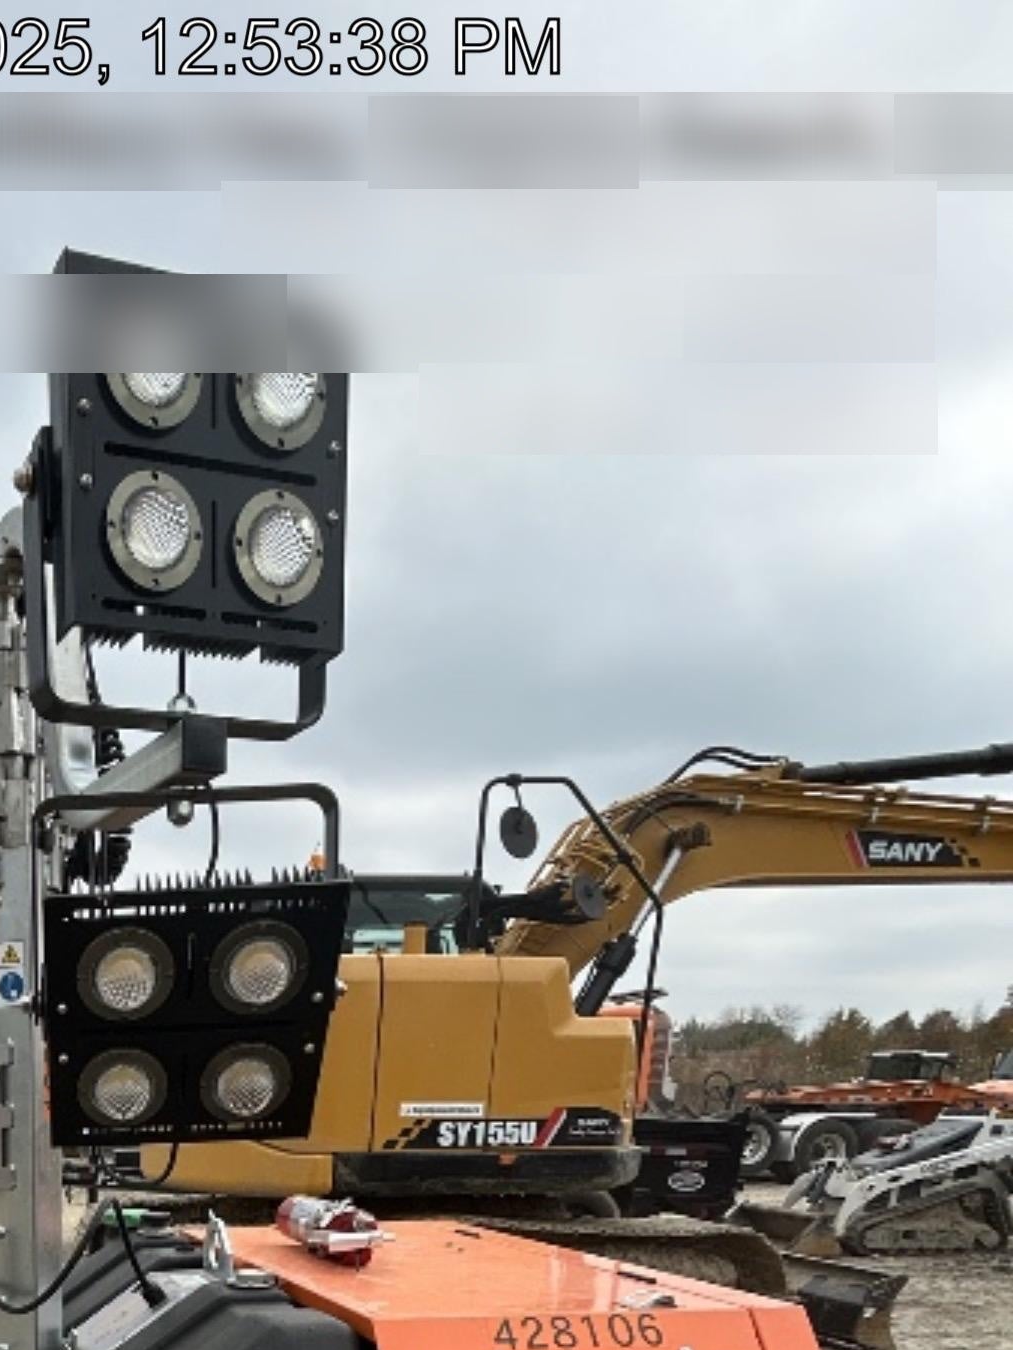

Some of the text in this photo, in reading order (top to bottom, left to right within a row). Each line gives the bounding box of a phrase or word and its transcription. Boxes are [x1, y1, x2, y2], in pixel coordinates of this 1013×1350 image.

[868, 839, 943, 862] SANY
[437, 1121, 537, 1147] SY155U
[493, 1313, 664, 1350] 428106
